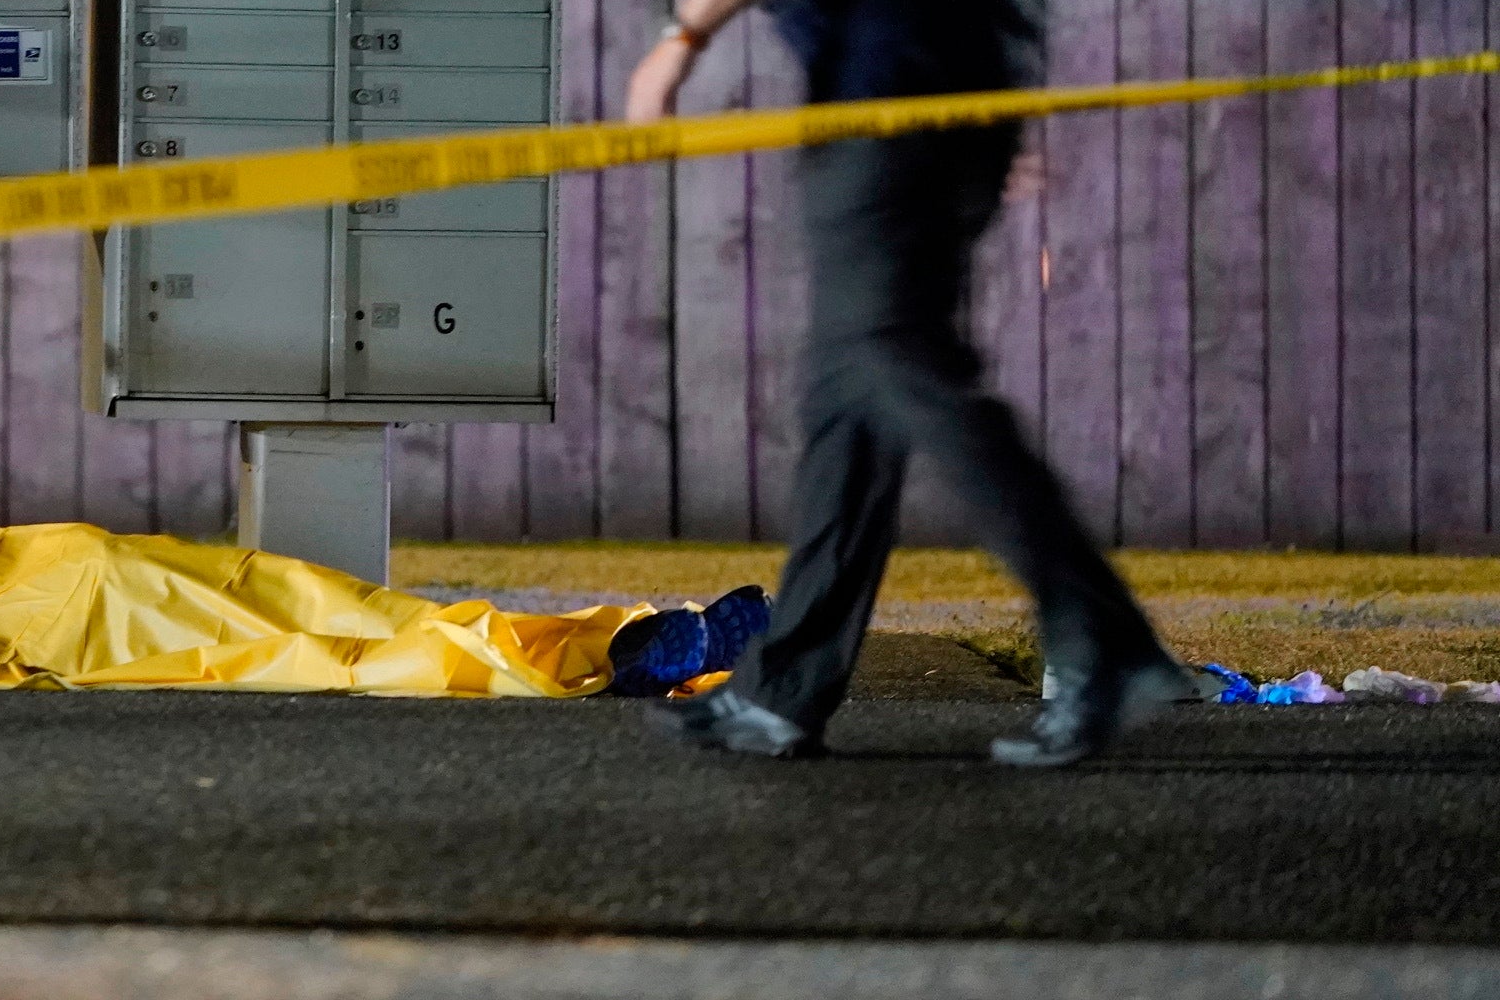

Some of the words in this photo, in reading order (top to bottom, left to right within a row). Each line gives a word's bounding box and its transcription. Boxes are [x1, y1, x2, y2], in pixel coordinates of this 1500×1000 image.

[377, 33, 400, 51] 13
[167, 85, 179, 102] 7
[166, 140, 178, 157] 8
[434, 302, 456, 334] G
